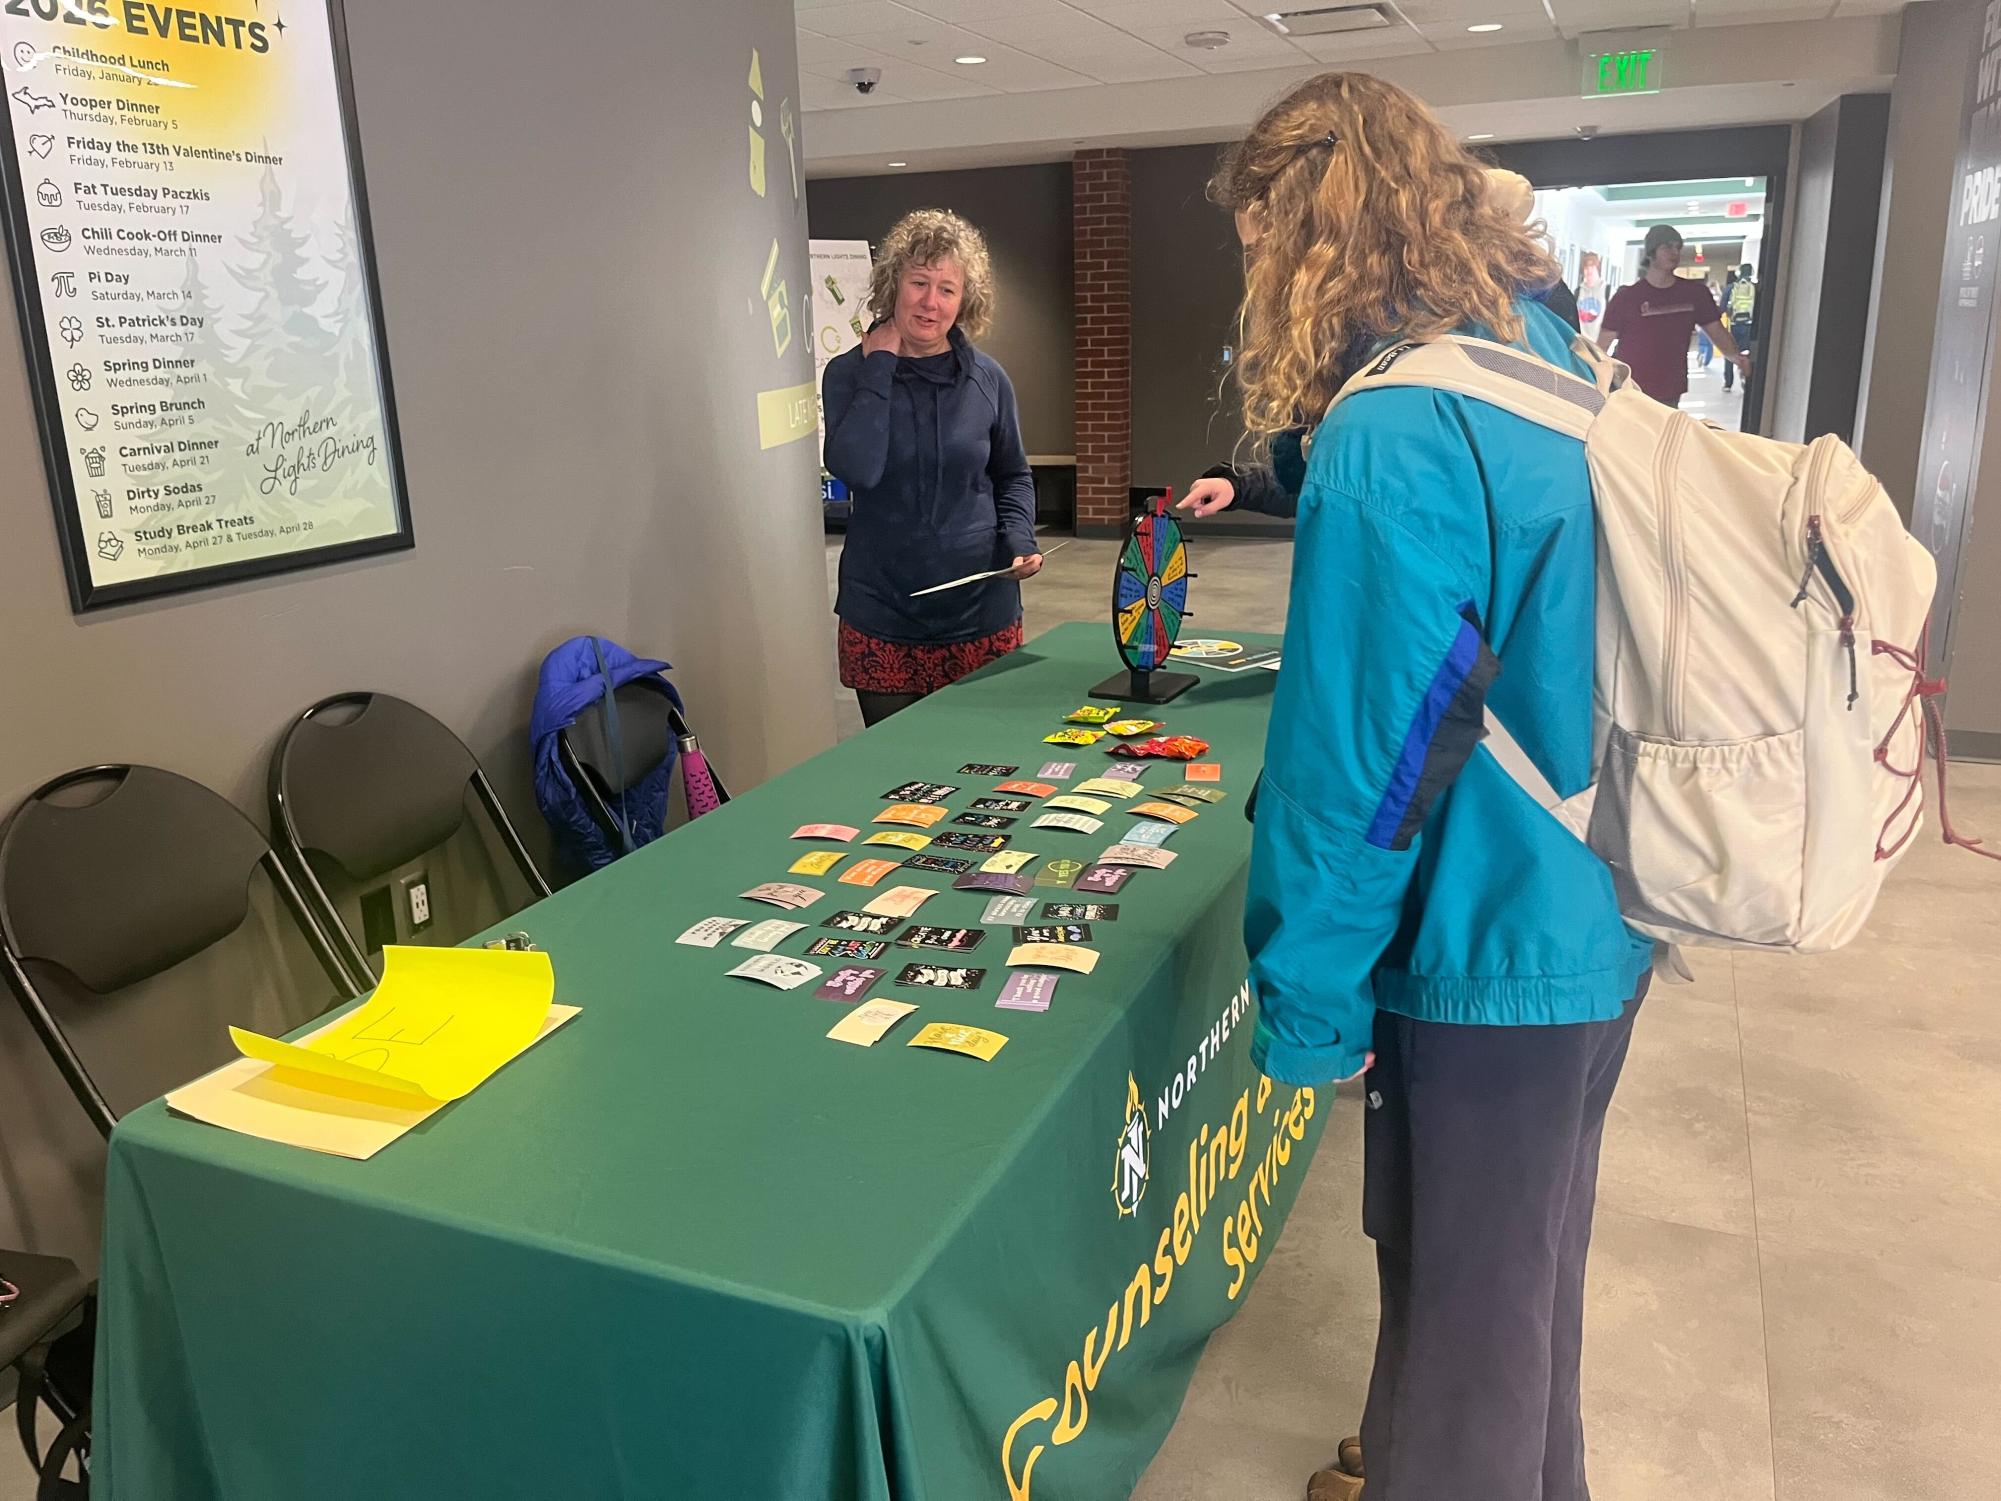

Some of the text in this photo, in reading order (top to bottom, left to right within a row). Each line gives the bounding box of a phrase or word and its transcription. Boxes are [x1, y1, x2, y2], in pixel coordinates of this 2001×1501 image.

[123, 0, 270, 54] EVENTS
[52, 45, 170, 72] Childhood Lunch
[55, 64, 95, 80] Friday,
[99, 70, 142, 86] January
[1599, 53, 1652, 92] EXIT
[59, 92, 160, 115] Yooper Dinner
[62, 109, 178, 131] Thursday, February 5
[67, 136, 283, 165] Friday the 13th Valentine's Dinner
[69, 154, 175, 172] Friday, February 13
[74, 182, 211, 201] Fat Tuesday Paczkis
[1960, 165, 2001, 226] PRIDE
[76, 200, 190, 217] Tuesday, February 17
[81, 227, 223, 244] Chili Cook-Off Dinner
[84, 245, 198, 258] Wednesday, March 11
[88, 271, 130, 285] Pi Day
[91, 290, 192, 302] Saturday, March 14
[96, 315, 204, 329] St. Patrick's Day
[99, 332, 195, 345] Tuesday, March 17
[103, 357, 196, 374] Spring Dinner
[106, 373, 207, 388] Wednesday, April 1
[111, 398, 205, 417] Spring Brunch
[114, 415, 195, 431] Sunday, April 5
[246, 409, 337, 457] at Northern
[119, 440, 219, 458] Carnival Dinner
[121, 455, 210, 473] Tuesday, April 21
[260, 433, 377, 496] Lights Dining
[127, 482, 203, 501] Dirty Sodas
[129, 495, 216, 515] Monday, April 27
[134, 515, 255, 542] Study Break Treats
[137, 521, 314, 558] Monday, April 27 & Tuesday, April 28
[1158, 979, 1250, 1130] NORTHERN
[1222, 1087, 1316, 1300] Services
[1002, 1088, 1249, 1501] Counseling
